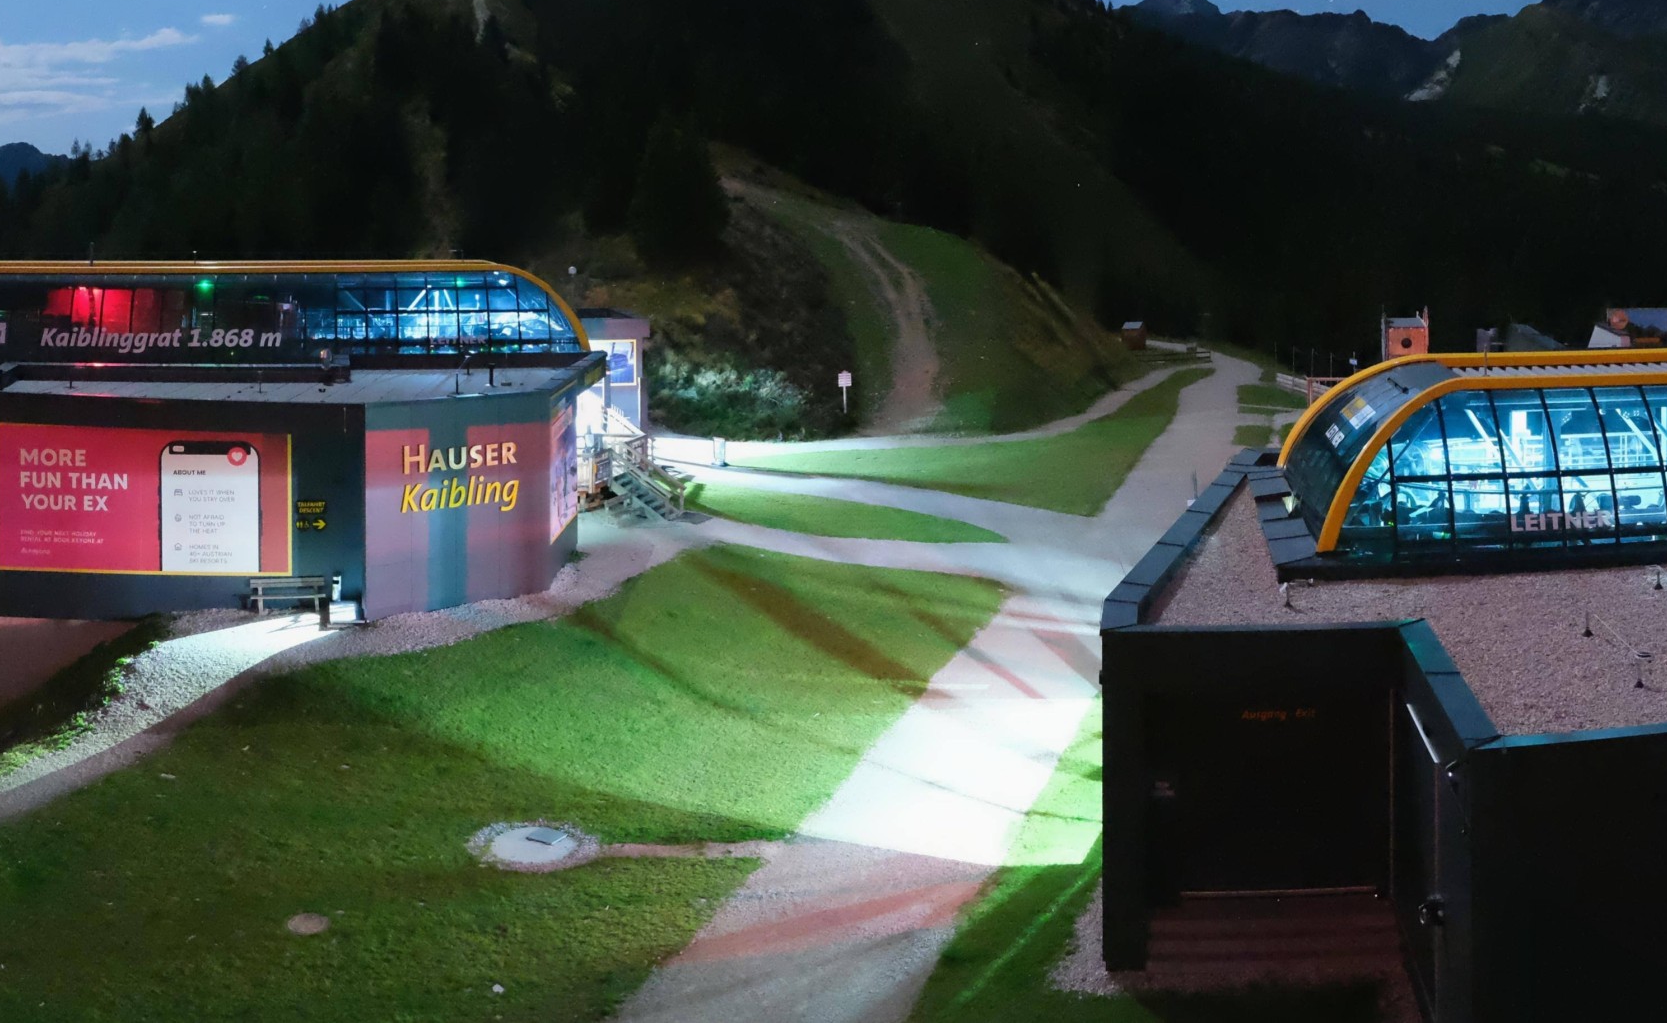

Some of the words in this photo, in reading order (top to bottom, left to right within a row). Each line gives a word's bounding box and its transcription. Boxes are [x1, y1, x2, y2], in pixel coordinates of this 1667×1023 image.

[40, 327, 181, 353] Kaiblinggrat
[187, 328, 254, 347] 1.868
[259, 332, 282, 347] m
[429, 335, 487, 345] LEITNER
[19, 448, 87, 467] MORE
[402, 441, 518, 475] HAUSER
[19, 470, 62, 489] FUN
[68, 473, 129, 490] THAN
[21, 493, 77, 511] YOUR
[83, 495, 109, 512] EX
[400, 475, 520, 513] Kaibling
[1510, 509, 1615, 533] LEITNER
[1241, 709, 1287, 721] Ausgang
[1295, 708, 1316, 718] Exit
